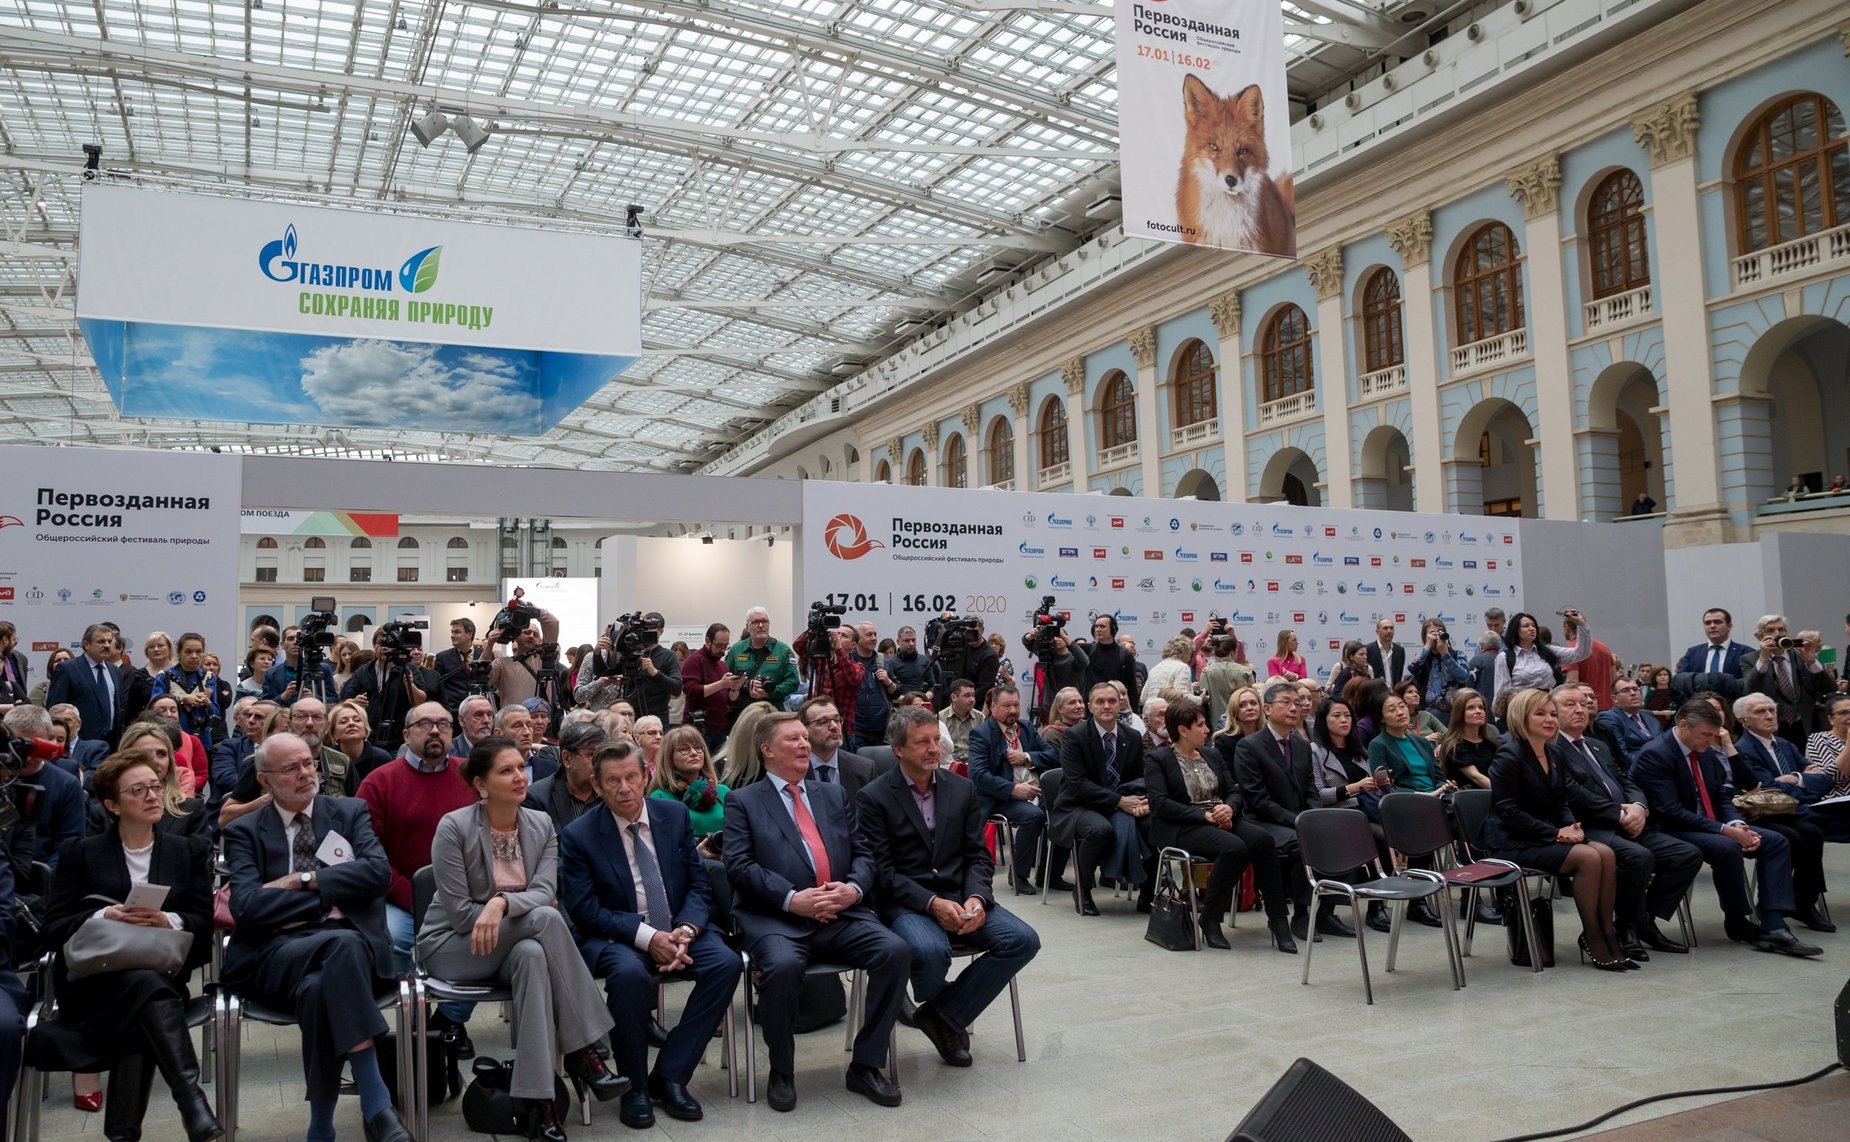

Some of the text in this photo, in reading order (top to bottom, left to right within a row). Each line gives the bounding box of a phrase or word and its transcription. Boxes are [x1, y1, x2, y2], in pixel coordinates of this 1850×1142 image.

[1133, 3, 1240, 39] Первозданная
[1134, 18, 1187, 42] Россия
[1137, 44, 1211, 70] 17.01 16.02
[1146, 220, 1196, 235] fotocult.ru
[299, 262, 392, 291] ГАЗПРОМ
[299, 292, 494, 331] СОХРАНЯЯ ПРИРОДУ
[37, 488, 210, 510] Первозданная
[36, 508, 122, 527] Россия
[256, 510, 290, 519] ПОЕЗДА
[892, 518, 1003, 536] Первозданная
[36, 533, 210, 546] Общероссийский фестиваль природы
[892, 534, 948, 550] Россия
[825, 593, 1007, 613] 17.01 16.02 2020
